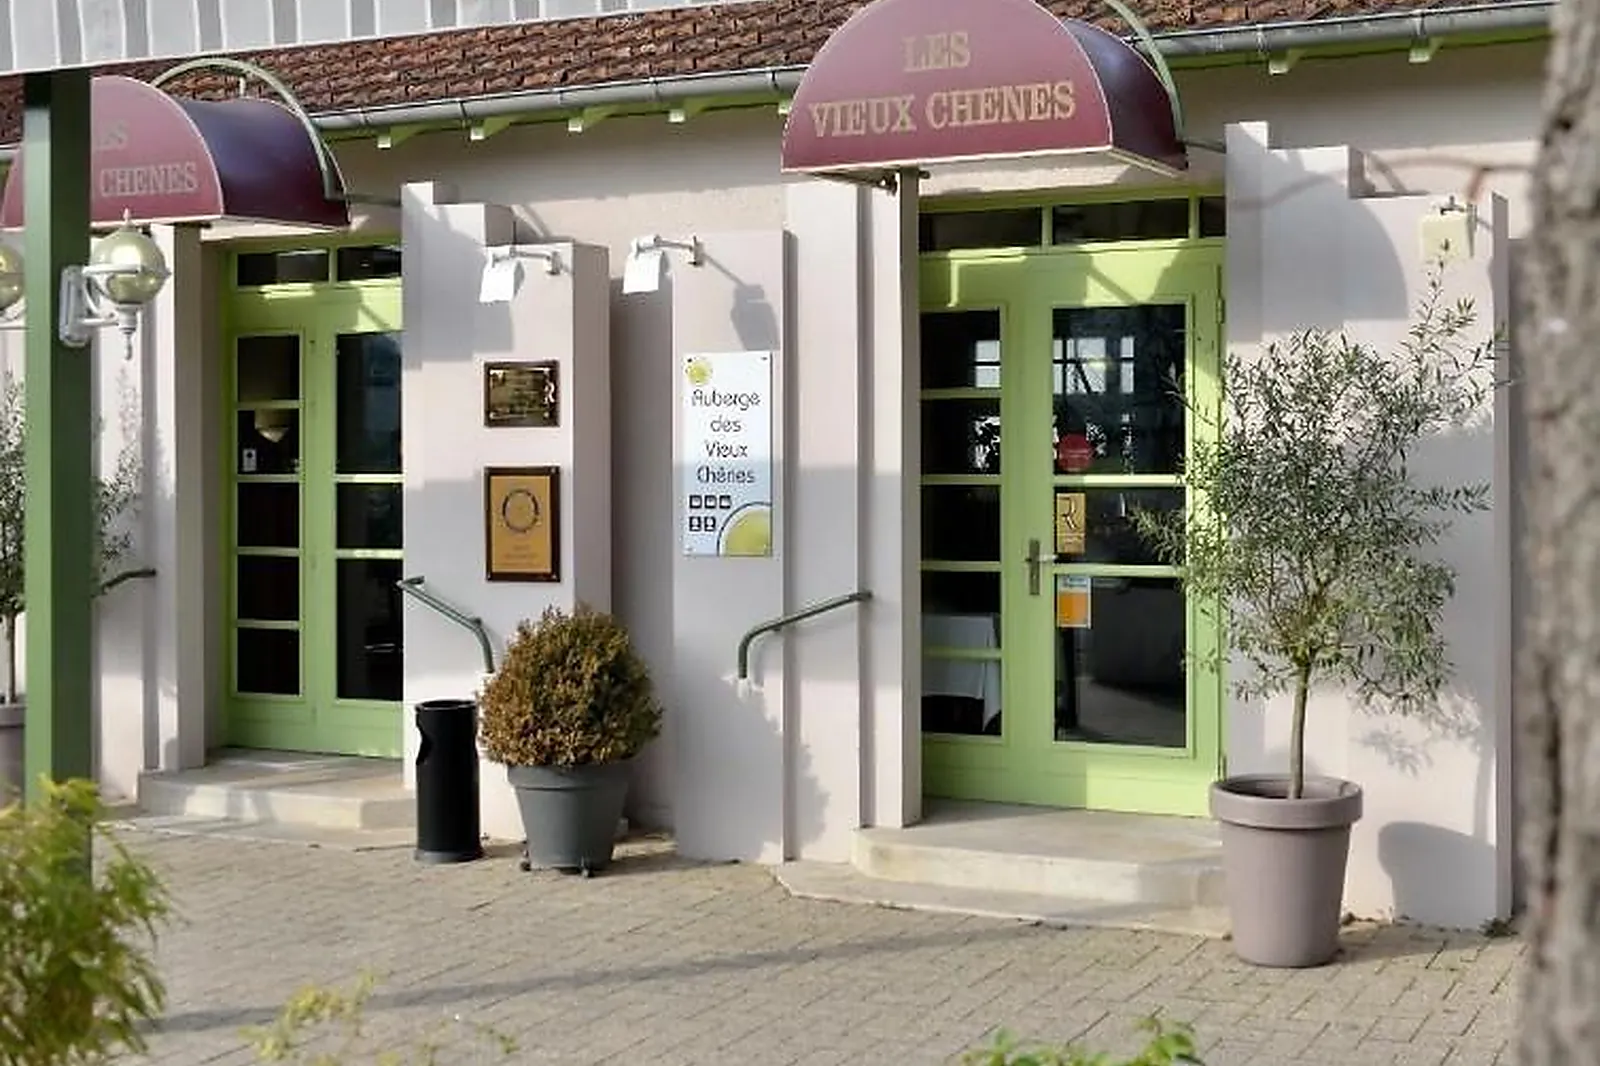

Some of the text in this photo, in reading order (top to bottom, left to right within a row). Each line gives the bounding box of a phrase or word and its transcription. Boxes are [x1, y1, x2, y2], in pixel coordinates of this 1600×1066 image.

[902, 31, 971, 73] LES
[808, 80, 1077, 138] VIEUX CHENES
[101, 161, 199, 198] CHENES
[692, 388, 761, 411] Auberge
[710, 414, 742, 433] des
[704, 440, 748, 458] Vieux
[696, 465, 755, 484] Chênes
